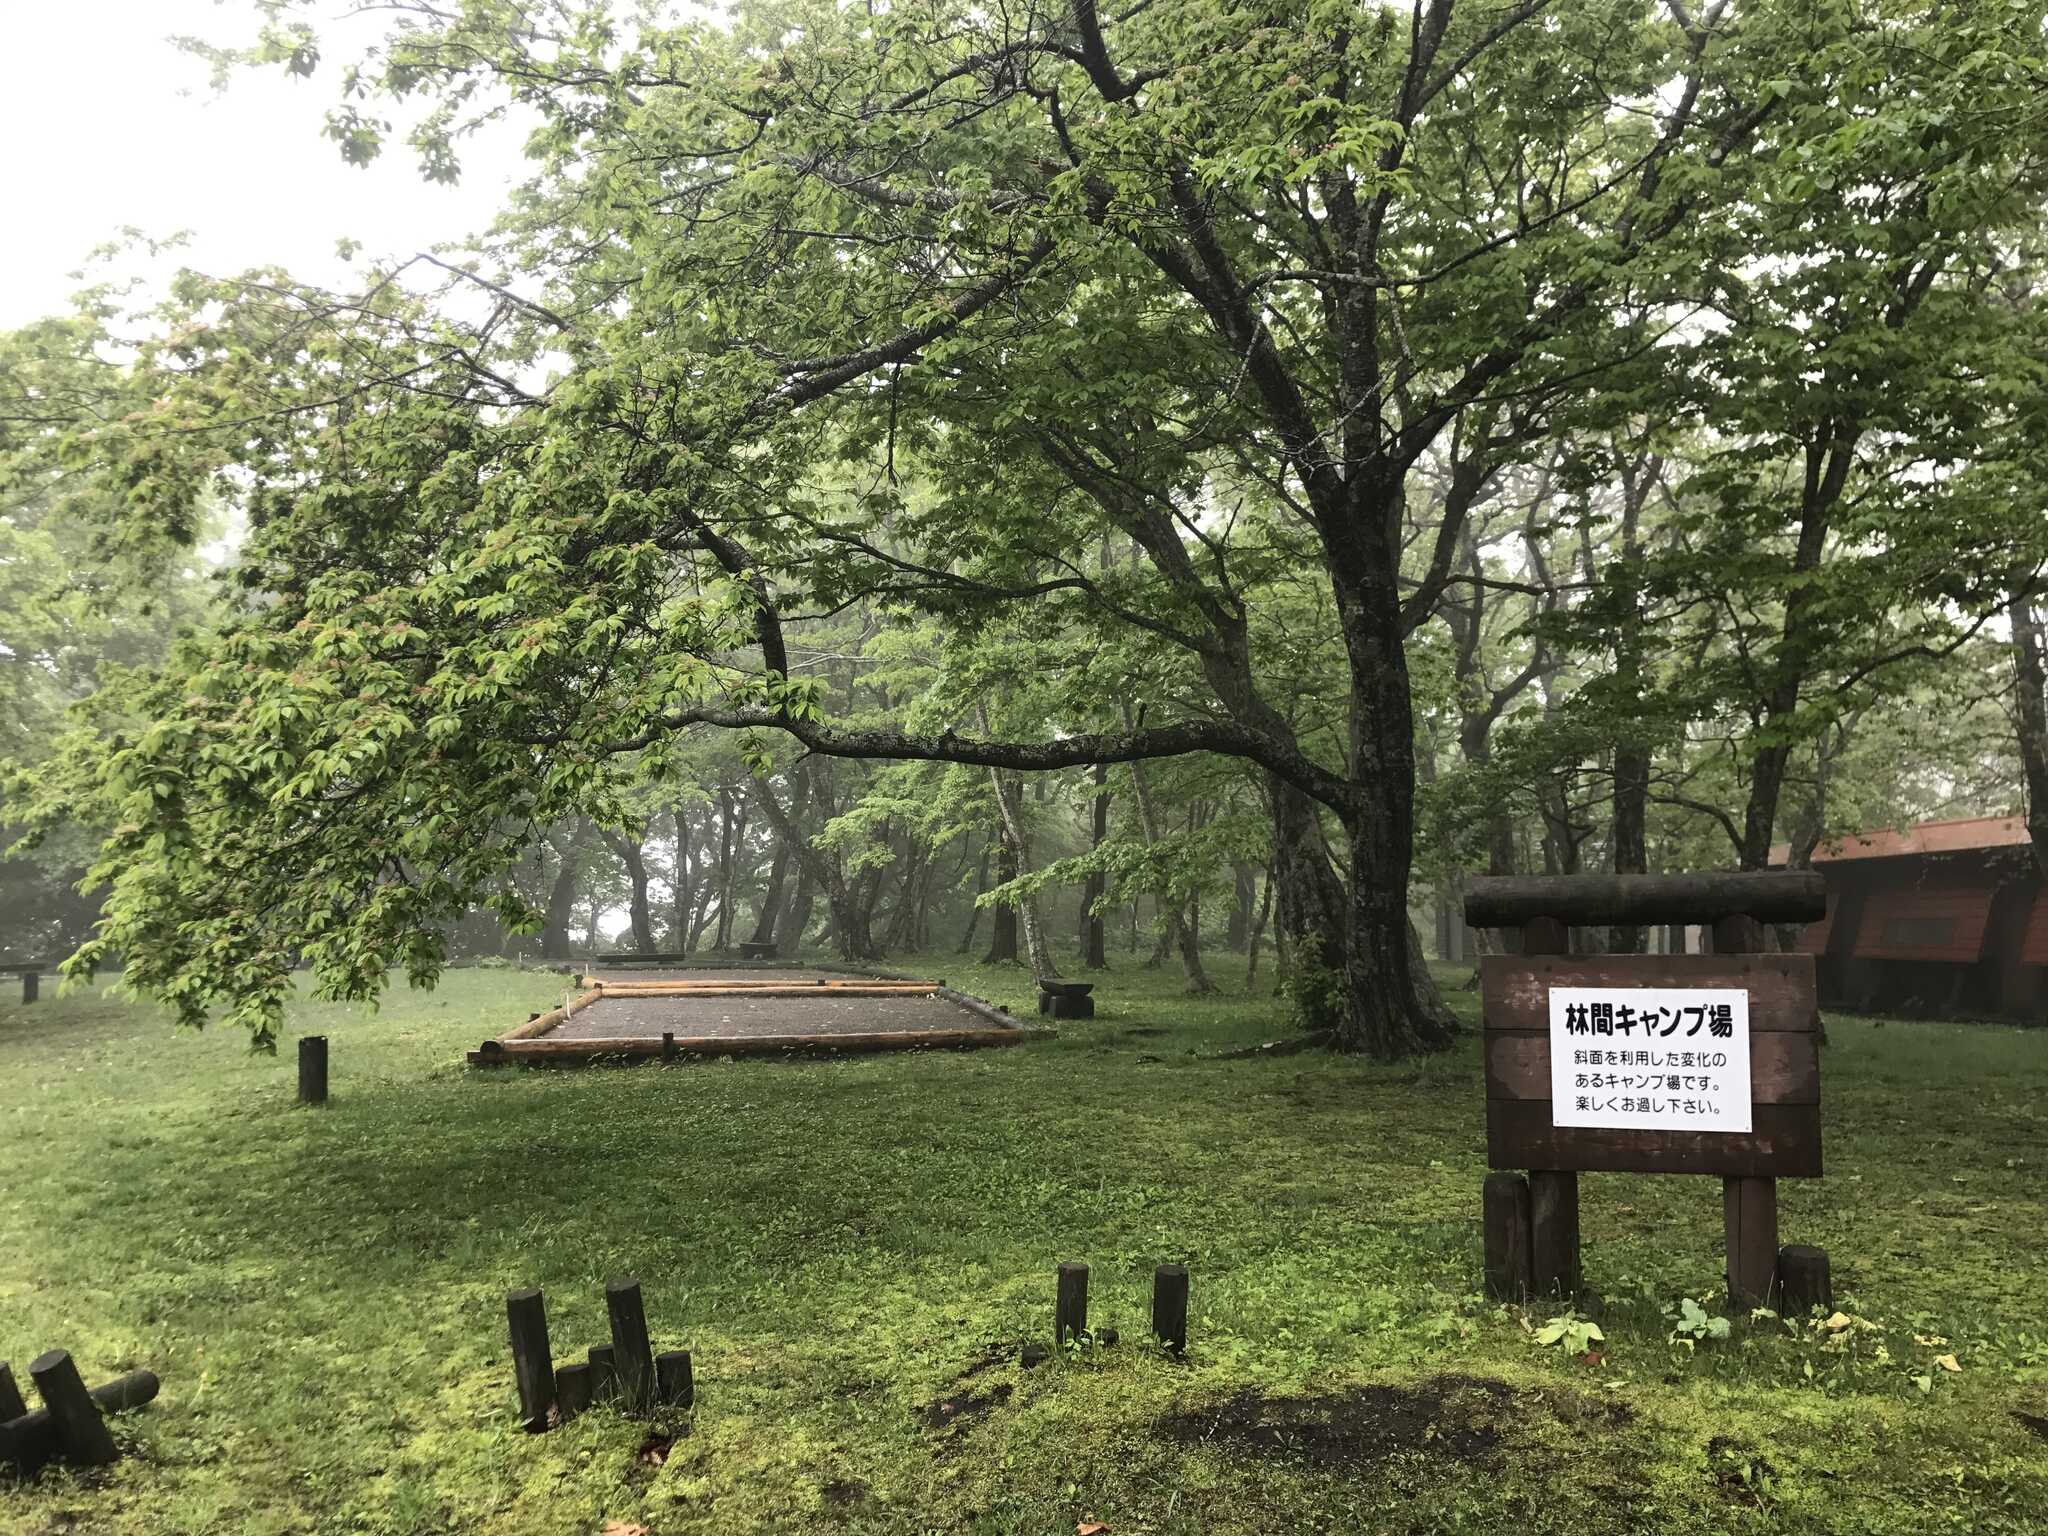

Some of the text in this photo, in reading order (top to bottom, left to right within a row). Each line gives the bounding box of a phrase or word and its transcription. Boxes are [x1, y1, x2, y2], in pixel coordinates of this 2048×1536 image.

[1566, 1002, 1732, 1038] 林間キャンプ場
[1574, 1049, 1727, 1067] 斜面を利用した変化の
[1575, 1073, 1720, 1091] あるキャンプ場です。
[1575, 1096, 1721, 1115] 楽しくお過し下さい。
